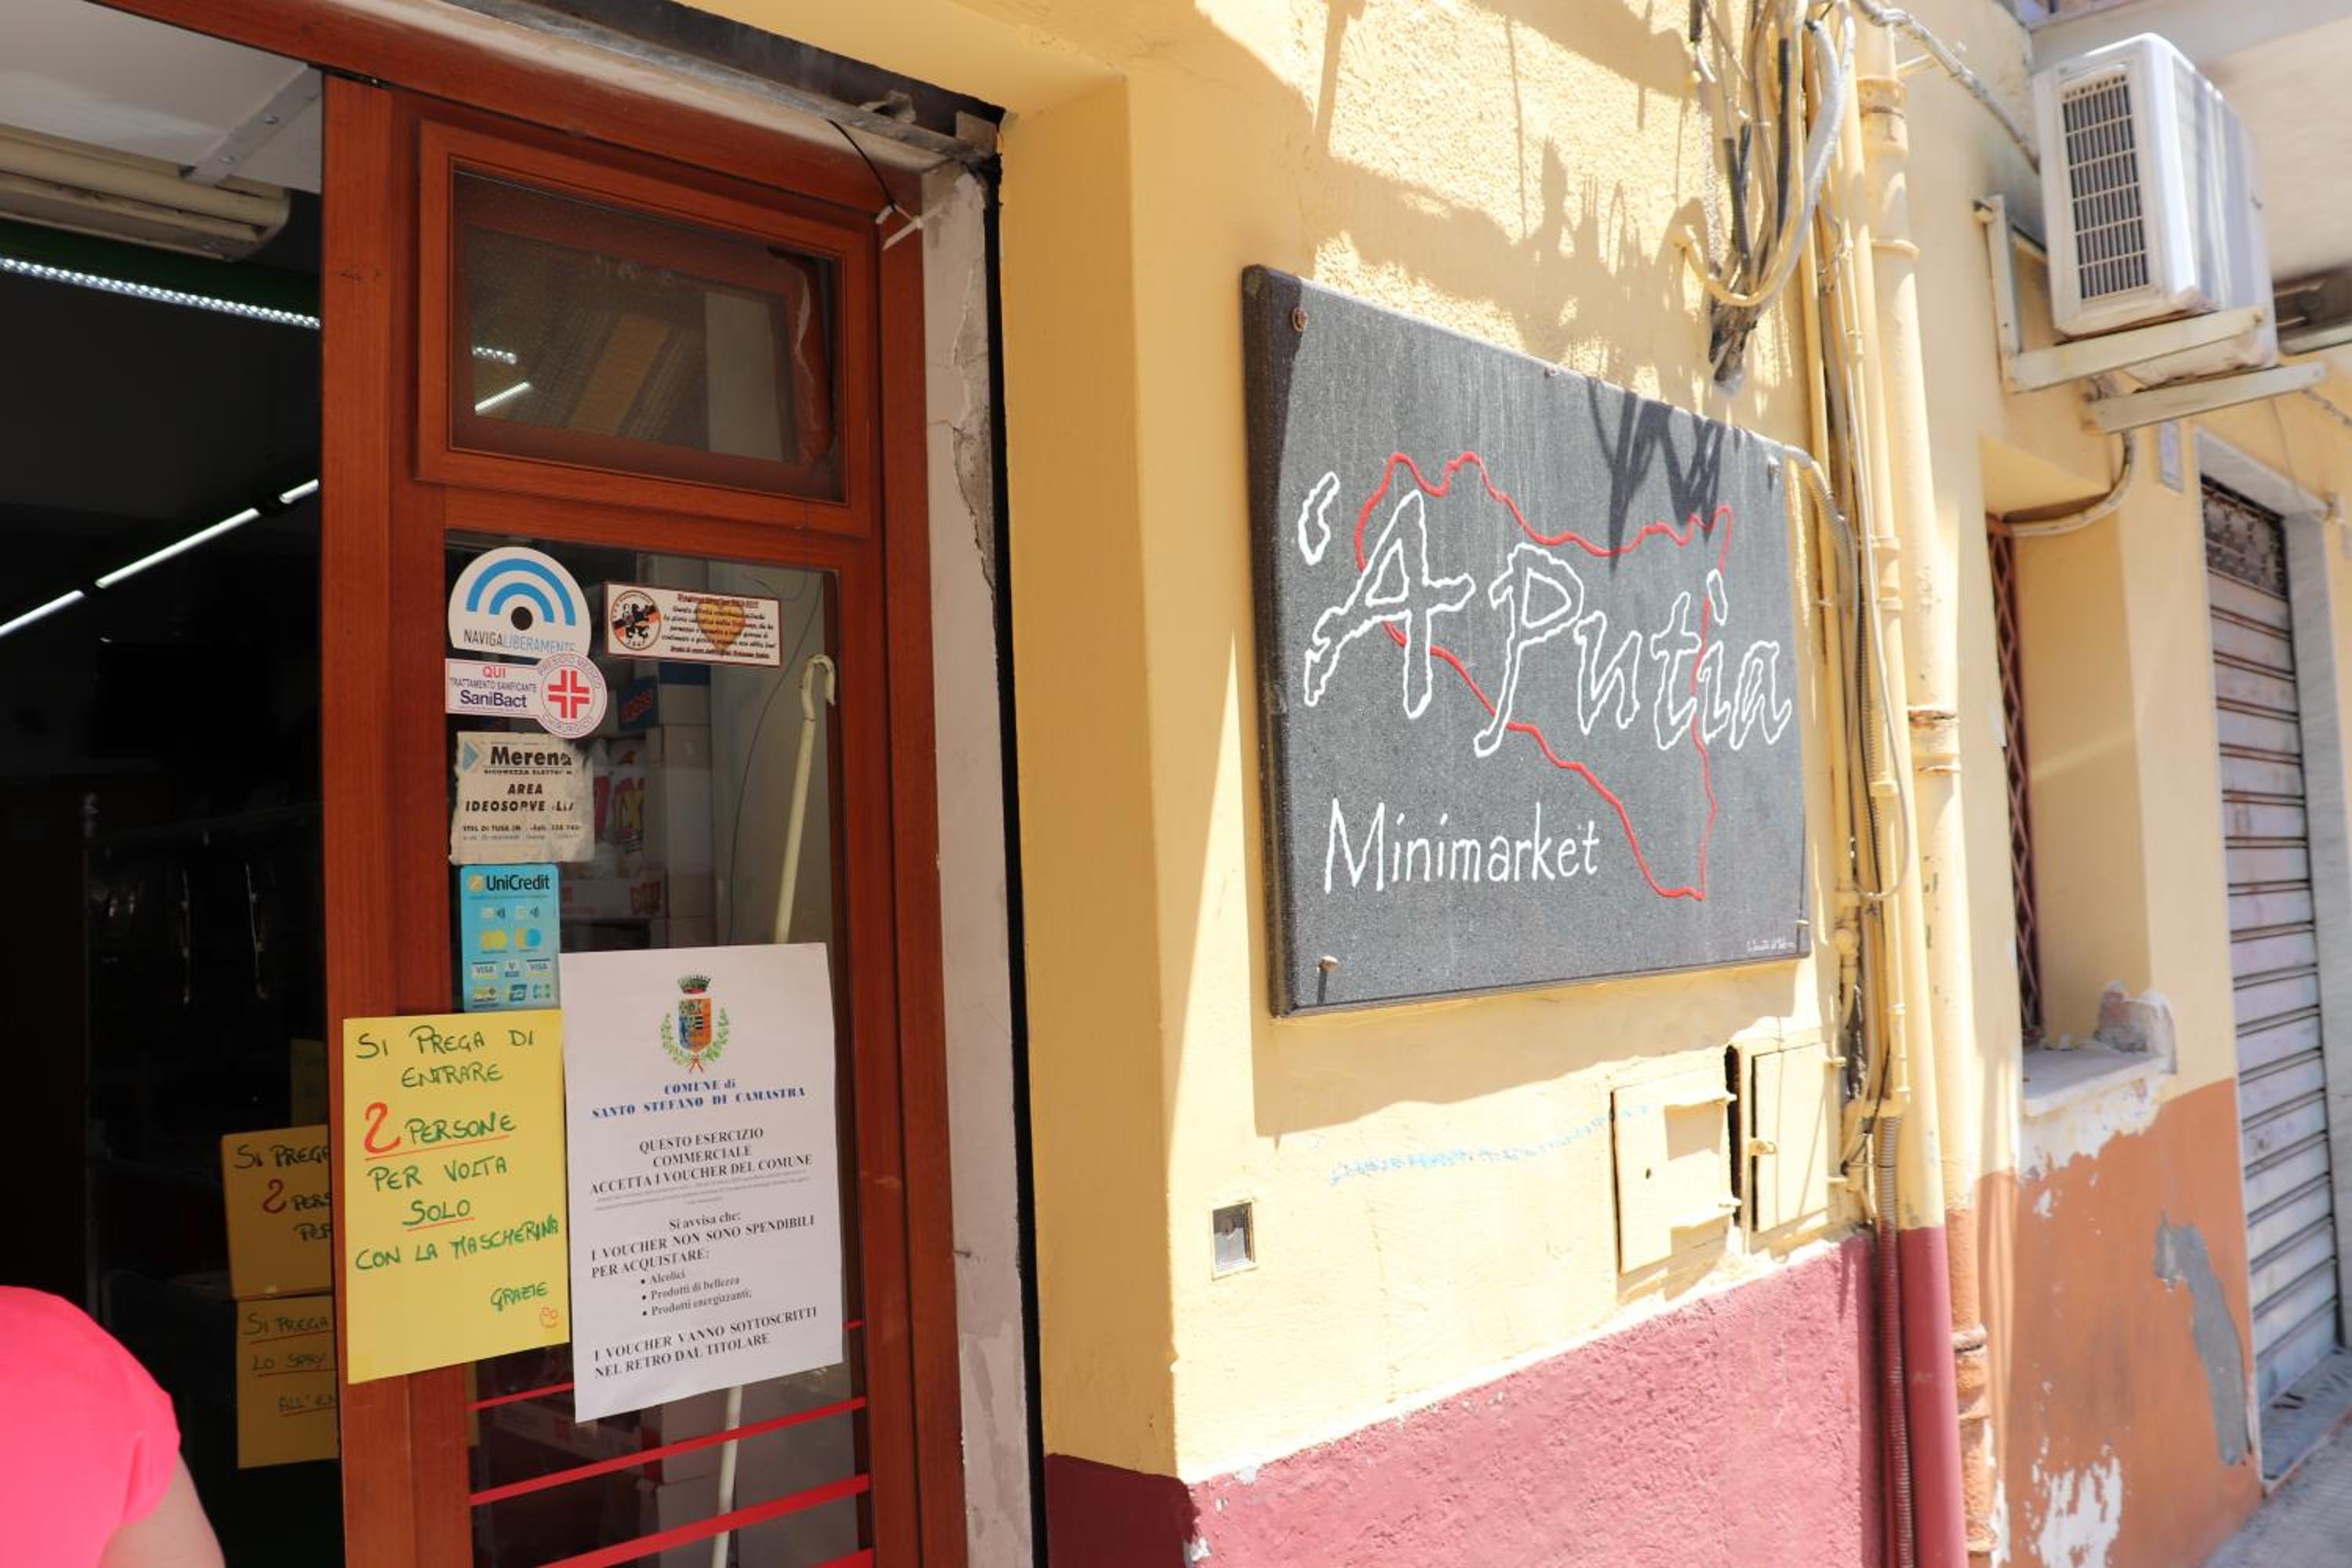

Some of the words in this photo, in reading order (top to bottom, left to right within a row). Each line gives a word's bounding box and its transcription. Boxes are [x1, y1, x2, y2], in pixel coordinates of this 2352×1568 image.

[450, 677, 495, 689] TRATTAMENTO
[482, 666, 506, 678] QUI
[460, 689, 528, 709] SaniBact
[507, 783, 543, 794] AREA
[1324, 797, 1600, 894] Minimarket
[486, 874, 550, 891] UniCredit
[356, 1033, 389, 1059] SI
[409, 1024, 485, 1054] PREGA
[508, 1029, 534, 1047] DI
[401, 1061, 503, 1088] ENTRARE
[664, 1080, 720, 1095] COMUNE
[724, 1078, 737, 1090] di
[591, 1105, 636, 1119] SANTO
[644, 1098, 704, 1113] STEFANO
[712, 1093, 728, 1105] DI
[735, 1087, 806, 1104] CAMASTRA
[364, 1102, 401, 1154] 2
[404, 1111, 517, 1145] PERSONE
[639, 1134, 693, 1154] QUESTO
[695, 1127, 764, 1146] ESERCIZIO
[652, 1145, 753, 1168] COMMERCIALE
[366, 1165, 423, 1192] PER
[444, 1155, 508, 1183] VOLTA
[590, 1174, 652, 1195] ACCETTA
[655, 1173, 662, 1186] I
[662, 1164, 728, 1185] VOUCHER
[731, 1162, 755, 1175] DEL
[758, 1153, 814, 1172] COMUNE
[263, 1178, 287, 1214] 2
[401, 1200, 471, 1225] SOLO
[668, 1218, 681, 1230] Si
[682, 1214, 717, 1229] avvisa
[719, 1211, 741, 1224] che:
[355, 1247, 402, 1270] CON
[415, 1243, 439, 1262] LA
[450, 1214, 560, 1260] MASCHERINA
[591, 1249, 597, 1261] I
[601, 1238, 668, 1260] VOUCHER
[673, 1232, 702, 1247] NON
[706, 1226, 742, 1242] SONO
[745, 1214, 815, 1236] SPENDIBILI
[591, 1264, 619, 1279] PER
[621, 1248, 711, 1274] ACQUISTARE:
[649, 1269, 687, 1285] Alcolici
[490, 1281, 548, 1312] GRAZIE
[651, 1283, 690, 1301] Prodotti
[691, 1282, 702, 1294] di
[702, 1276, 741, 1291] bellezza
[652, 1300, 691, 1317] Prodotti
[594, 1348, 600, 1363] I
[605, 1336, 673, 1359] VOUCHER
[677, 1326, 726, 1344] VANNO
[730, 1305, 818, 1332] SOTTOSCRITTI
[596, 1363, 622, 1380] NEL
[626, 1351, 673, 1373] RETRO
[675, 1347, 703, 1363] DAL
[707, 1332, 771, 1357] TITOLARE
